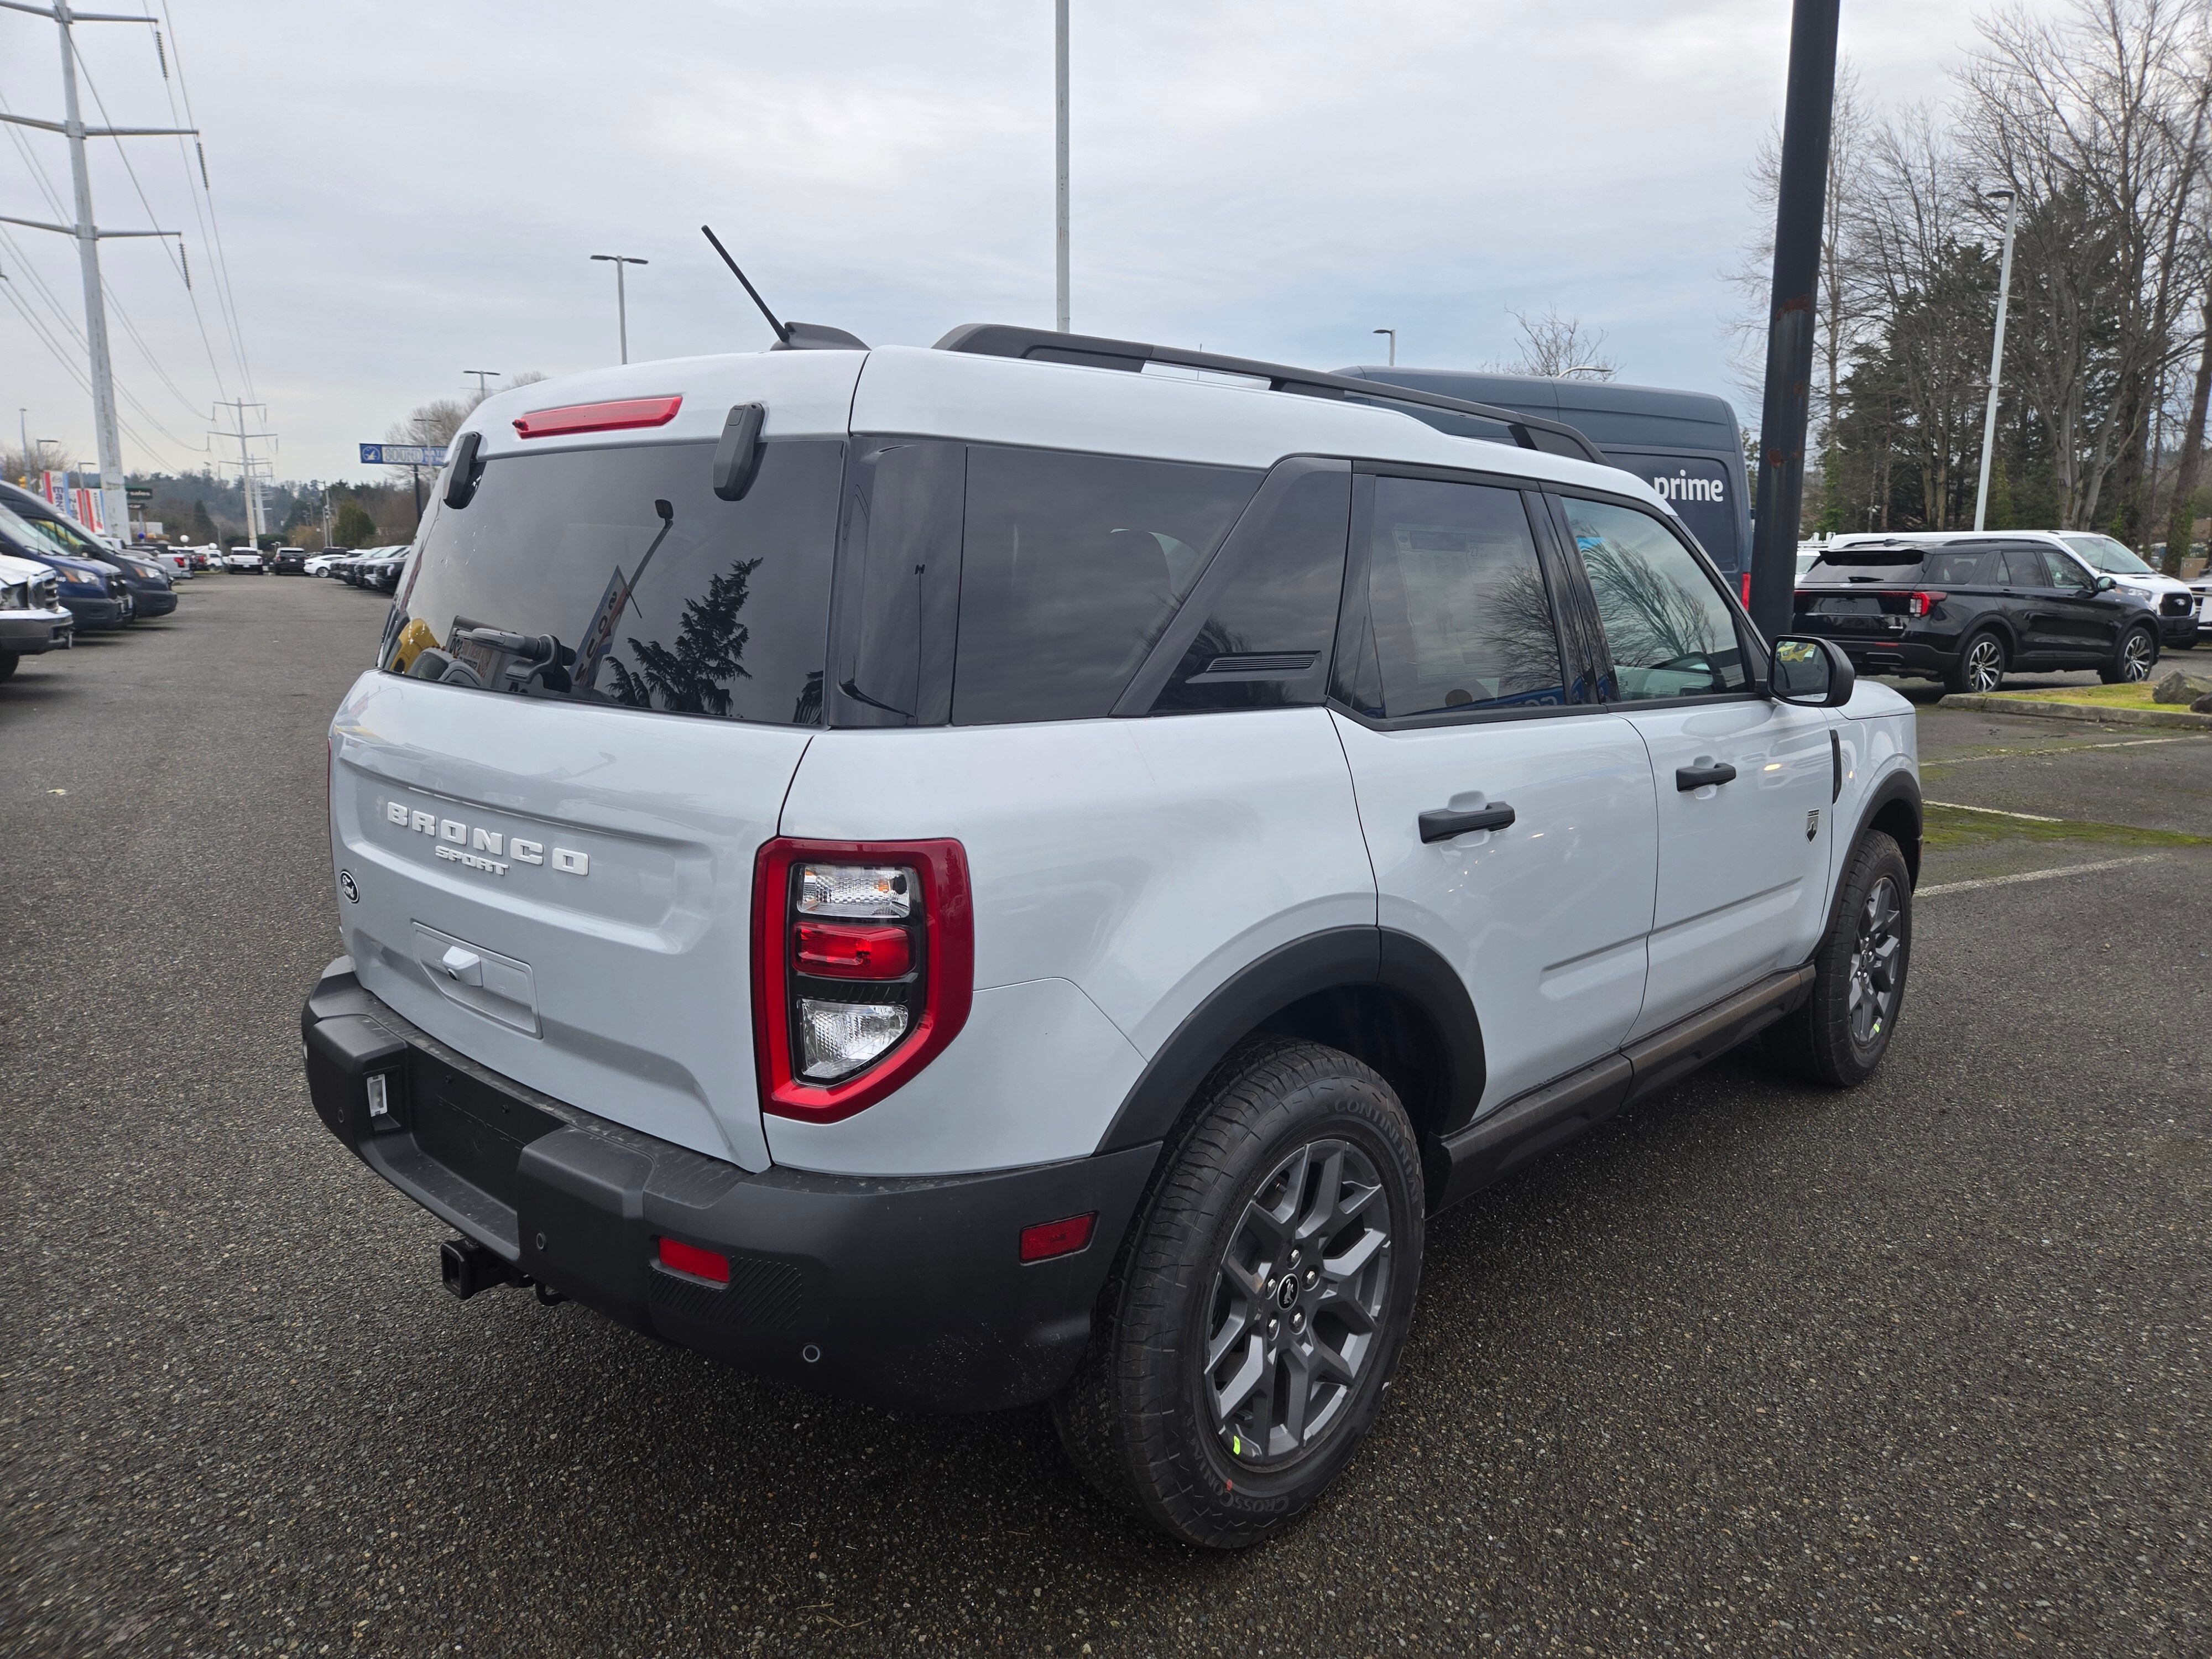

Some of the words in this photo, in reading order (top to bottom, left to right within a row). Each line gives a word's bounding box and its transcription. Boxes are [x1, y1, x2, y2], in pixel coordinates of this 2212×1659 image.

[384, 448, 422, 462] SOUND
[1653, 469, 1724, 502] prime
[387, 801, 589, 877] BRONCO
[435, 845, 510, 875] SPORT
[342, 875, 355, 899] Ford
